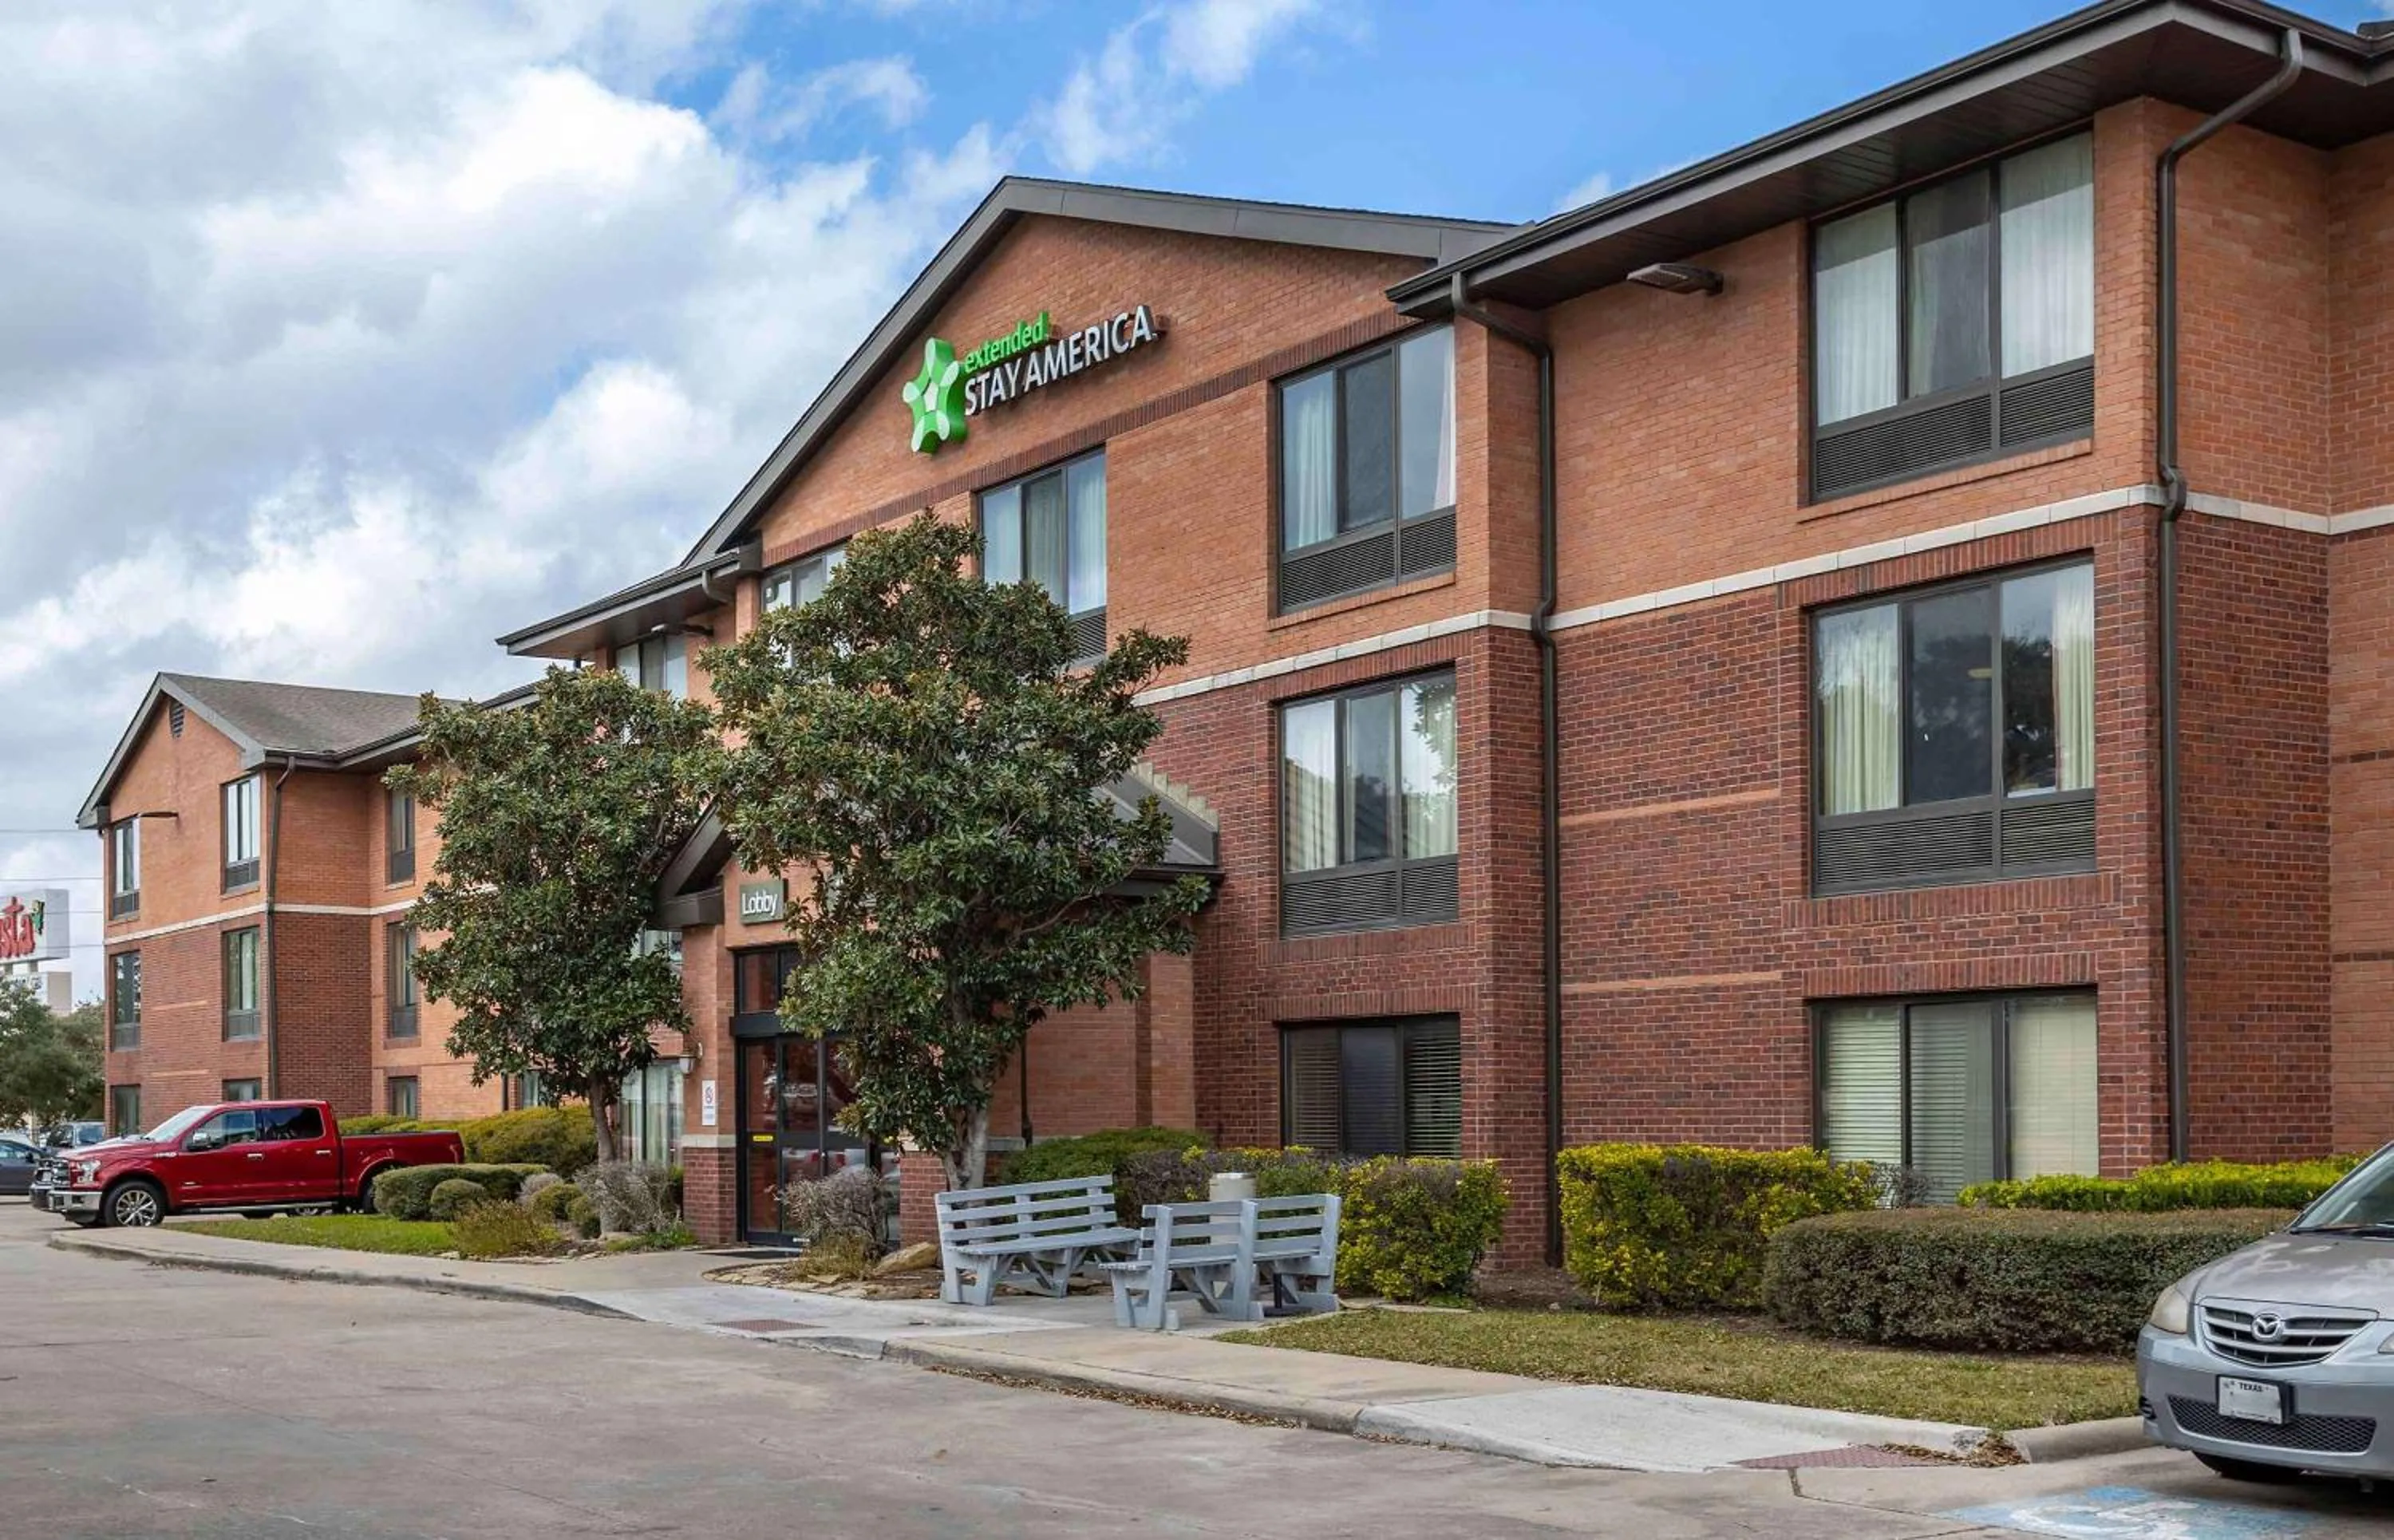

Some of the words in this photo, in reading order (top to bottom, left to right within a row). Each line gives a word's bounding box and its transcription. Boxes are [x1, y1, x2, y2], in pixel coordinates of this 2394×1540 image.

[964, 357, 1022, 416] STAY
[1024, 304, 1153, 393] AMERICA
[965, 311, 1047, 373] extended
[742, 889, 778, 916] Lobby
[2238, 1382, 2263, 1392] TEXAS
